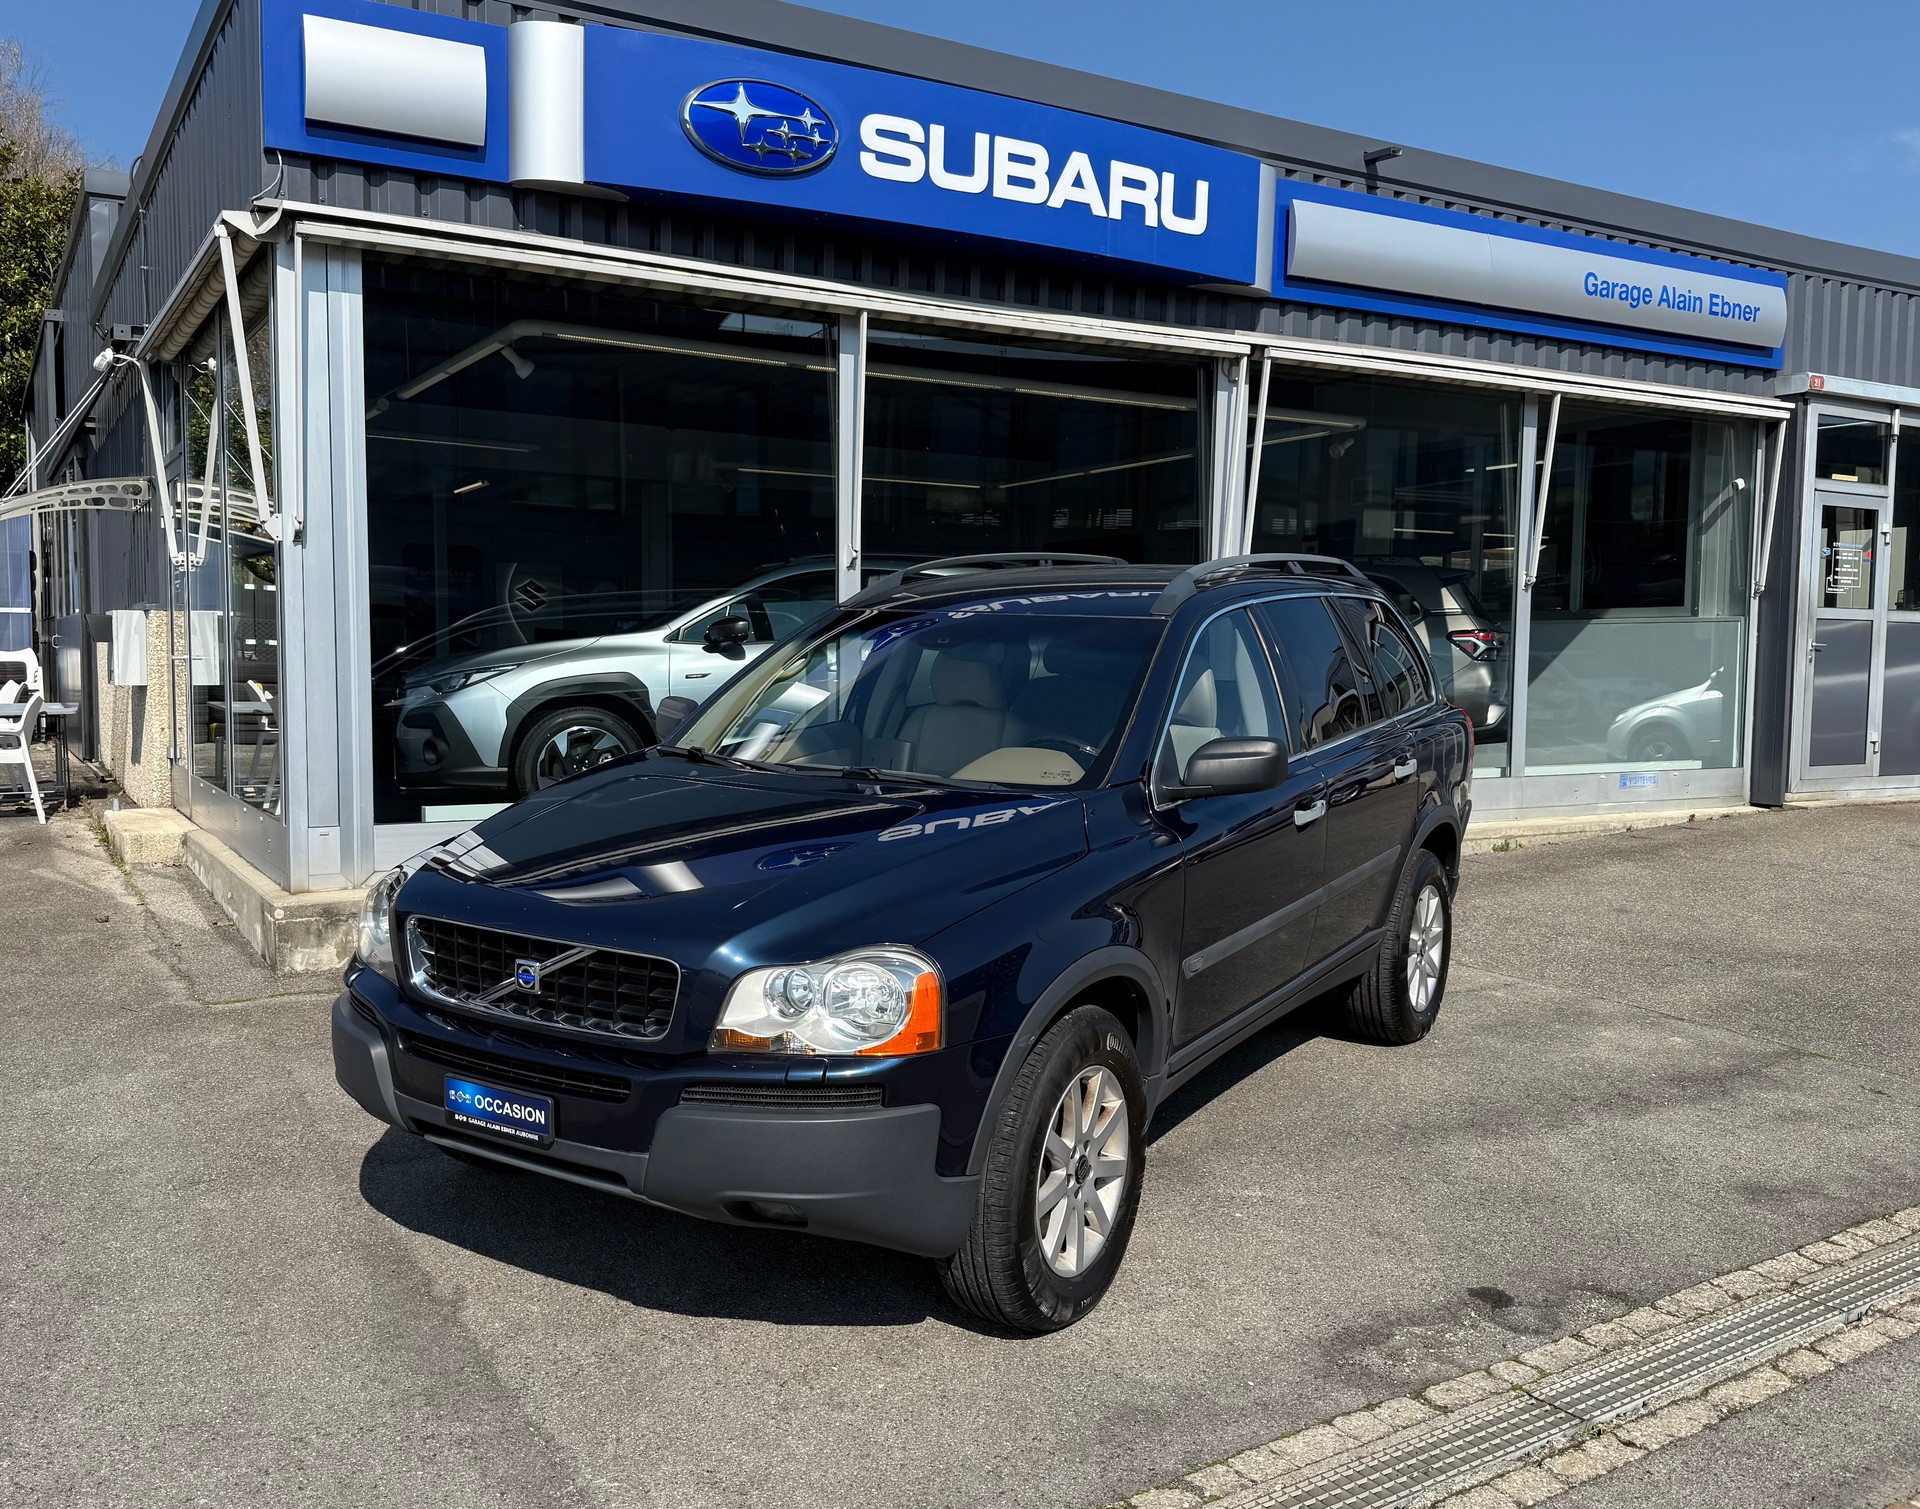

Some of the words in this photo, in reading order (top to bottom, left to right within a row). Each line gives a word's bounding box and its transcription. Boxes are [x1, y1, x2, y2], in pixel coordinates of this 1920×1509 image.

[859, 113, 1209, 236] SUBARU
[1584, 272, 1653, 309] Garage
[1657, 285, 1703, 313] Alain
[1709, 293, 1760, 322] Ebner
[467, 1117, 487, 1128] GARAGE
[486, 1122, 501, 1131] ALAIN
[474, 1095, 545, 1124] OCCASION
